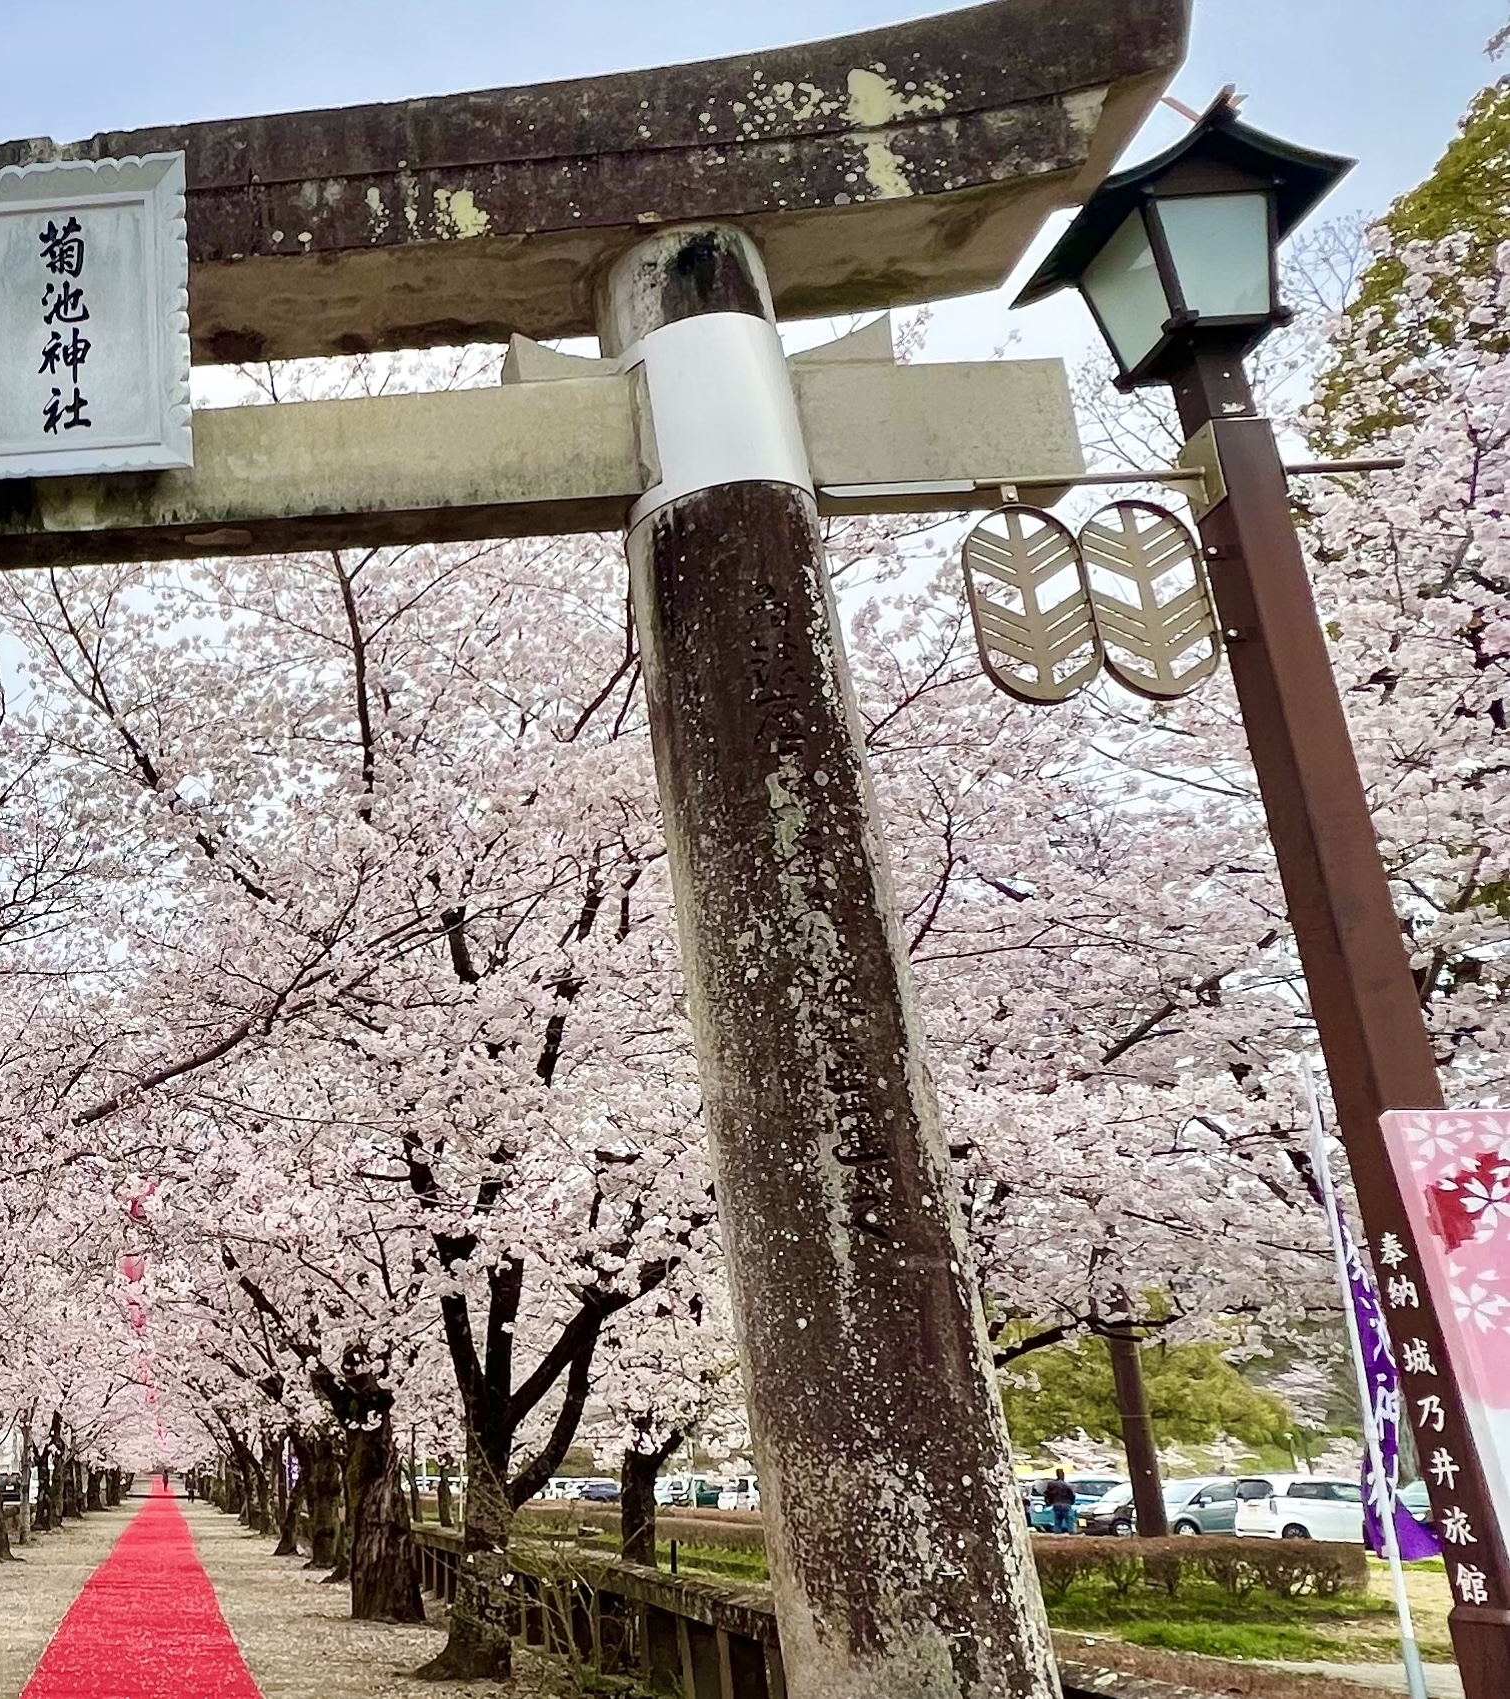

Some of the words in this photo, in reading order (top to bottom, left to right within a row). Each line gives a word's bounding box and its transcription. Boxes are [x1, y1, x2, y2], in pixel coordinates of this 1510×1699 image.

[38, 216, 92, 436] 菊池神社
[1378, 1231, 1420, 1310] 奉納
[1401, 1337, 1489, 1606] 城乃井旅館
